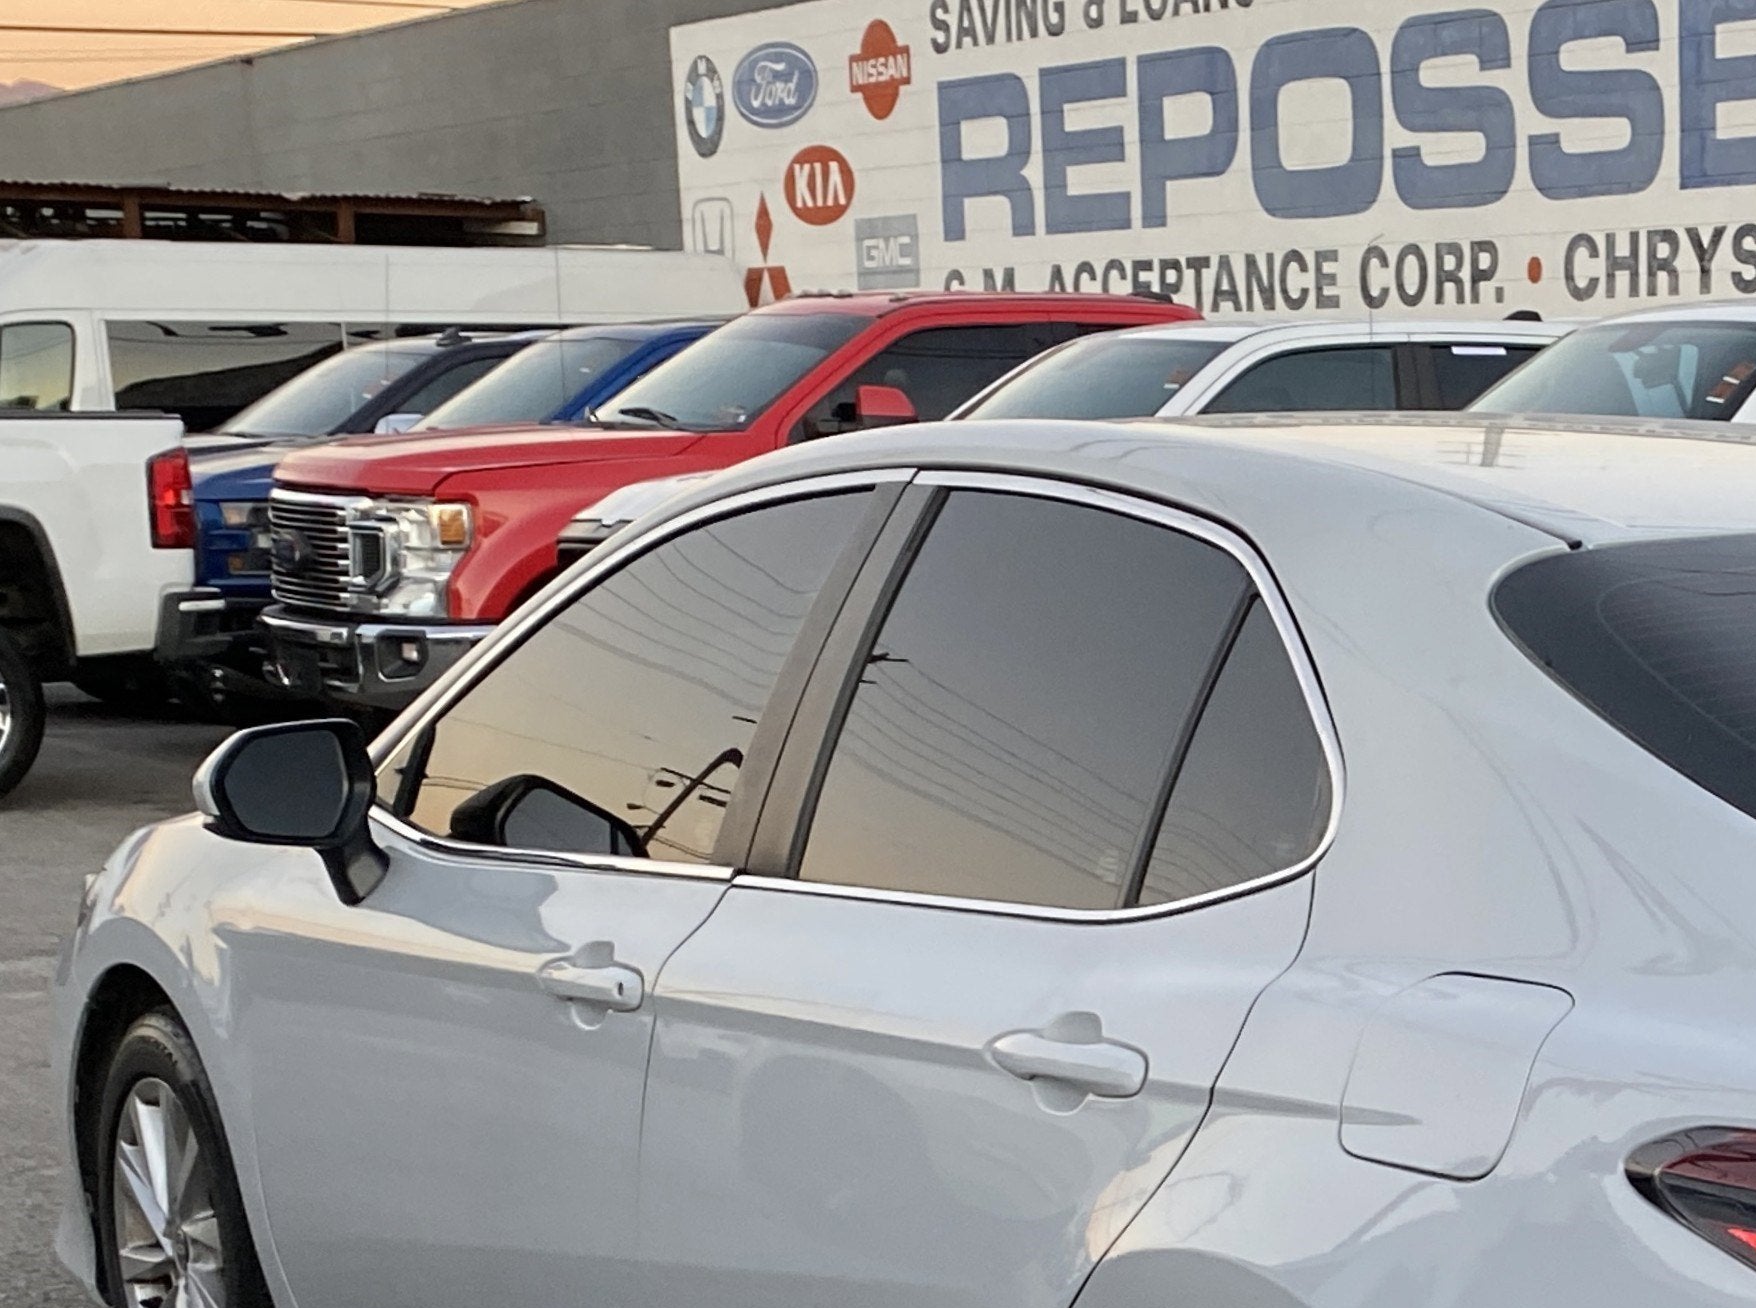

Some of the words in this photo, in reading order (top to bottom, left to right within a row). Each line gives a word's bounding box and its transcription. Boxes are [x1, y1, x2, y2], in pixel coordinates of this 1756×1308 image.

[750, 60, 799, 108] Ford
[851, 52, 908, 86] NISSAN
[793, 160, 846, 208] KIA
[862, 235, 912, 268] GMC
[1359, 238, 1504, 310] CORP.
